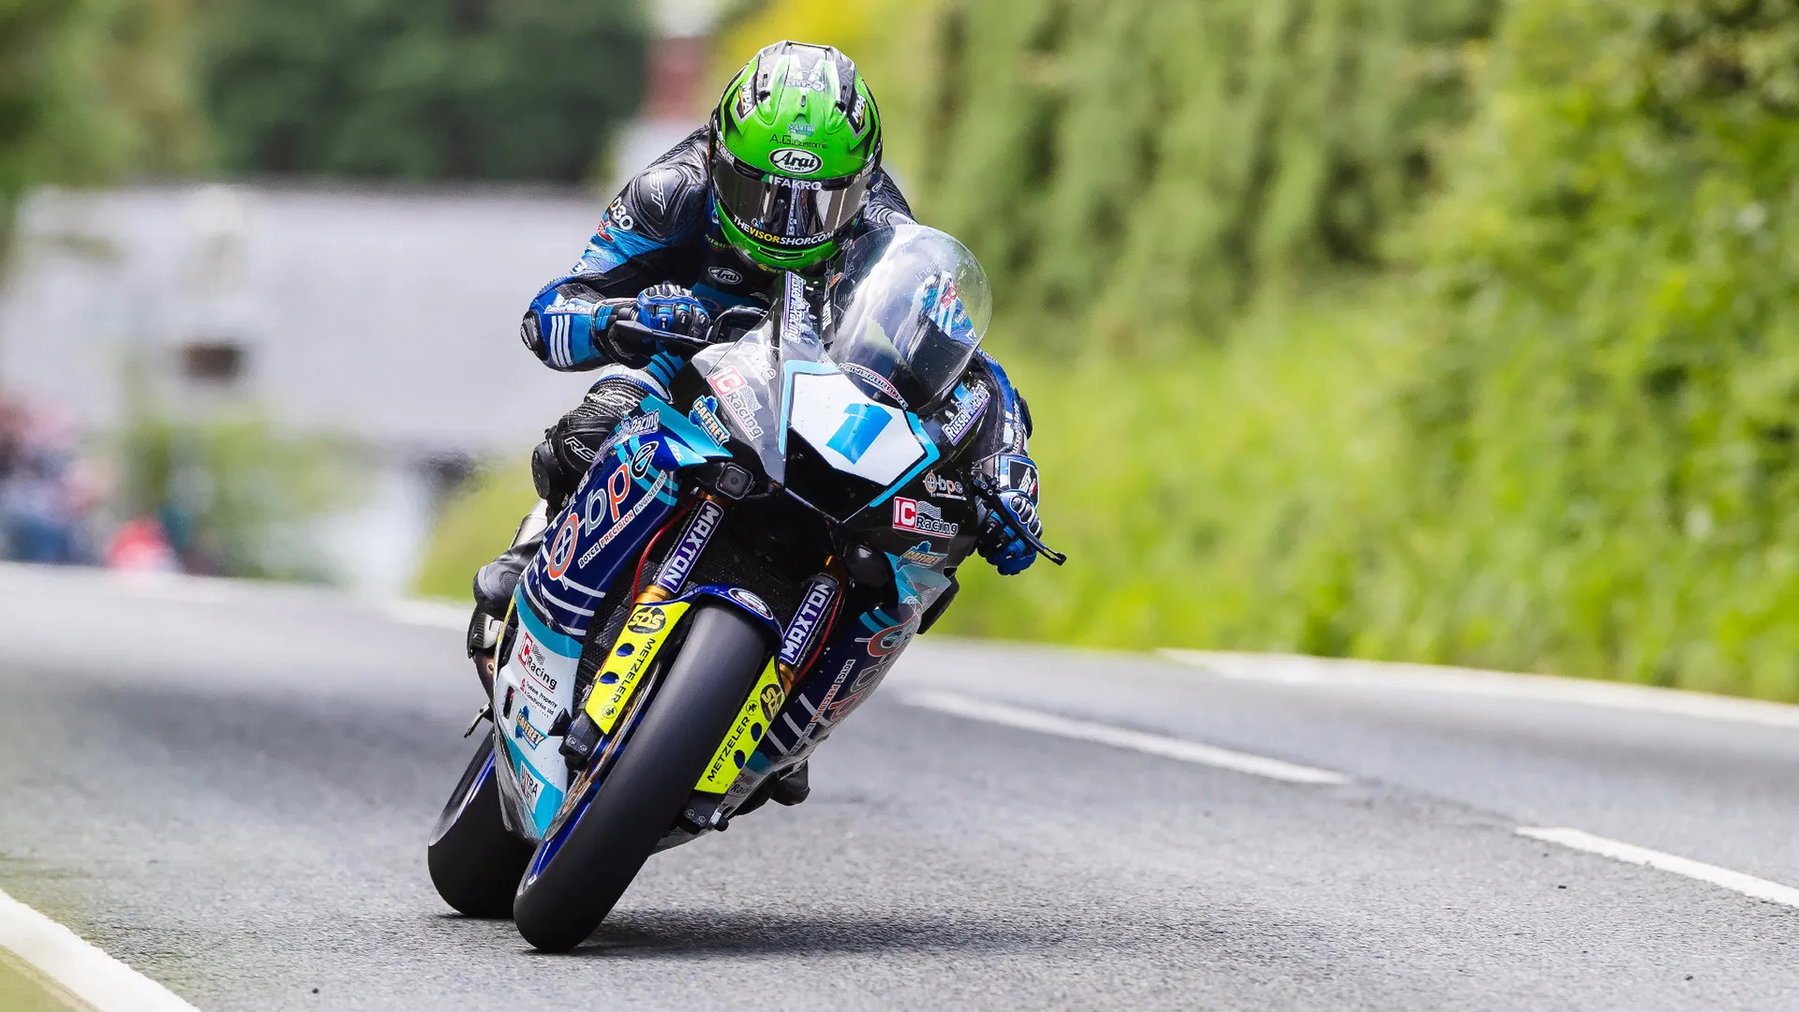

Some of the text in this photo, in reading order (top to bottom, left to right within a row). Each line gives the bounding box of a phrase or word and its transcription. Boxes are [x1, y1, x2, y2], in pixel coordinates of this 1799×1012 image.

[776, 151, 816, 169] Arai
[774, 177, 822, 190] FAKRO
[711, 269, 740, 283] Arai
[694, 400, 727, 442] CAFFREY
[727, 391, 763, 437] Racing
[826, 402, 893, 465] 1
[564, 436, 598, 462] RS
[599, 511, 635, 548] PRECISION
[894, 499, 959, 535] IC Racing
[663, 505, 720, 587] MAXTON
[781, 584, 830, 659] MAXTON
[527, 655, 558, 690] Racing
[612, 638, 656, 703] METZELER
[707, 716, 750, 782] METZELER
